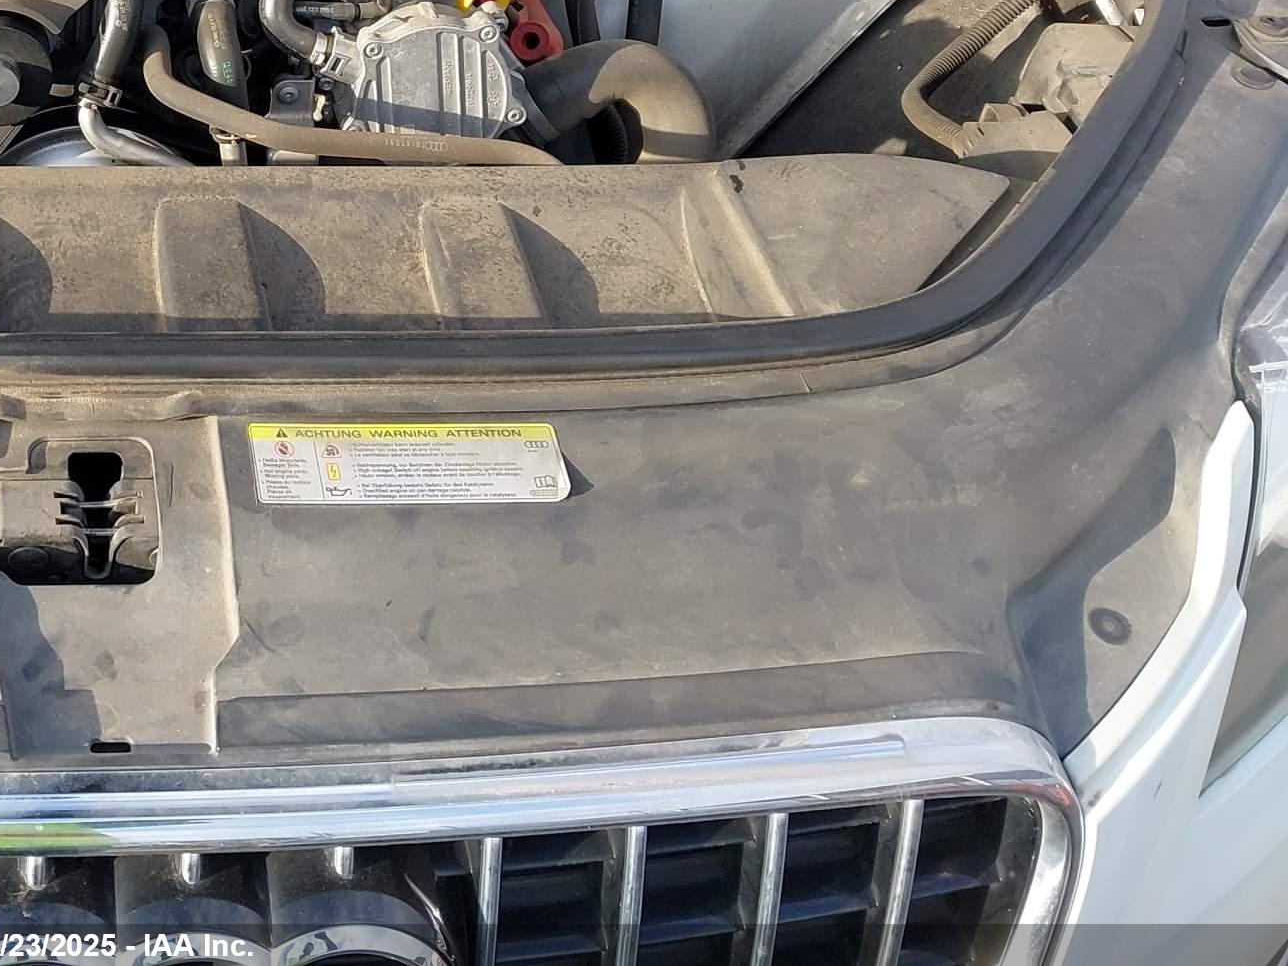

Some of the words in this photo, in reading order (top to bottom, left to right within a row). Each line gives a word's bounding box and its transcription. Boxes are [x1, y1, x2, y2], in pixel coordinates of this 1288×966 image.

[295, 429, 362, 439] ACHTUNG
[369, 429, 438, 438] WARNING
[446, 428, 522, 438] ATTENTION
